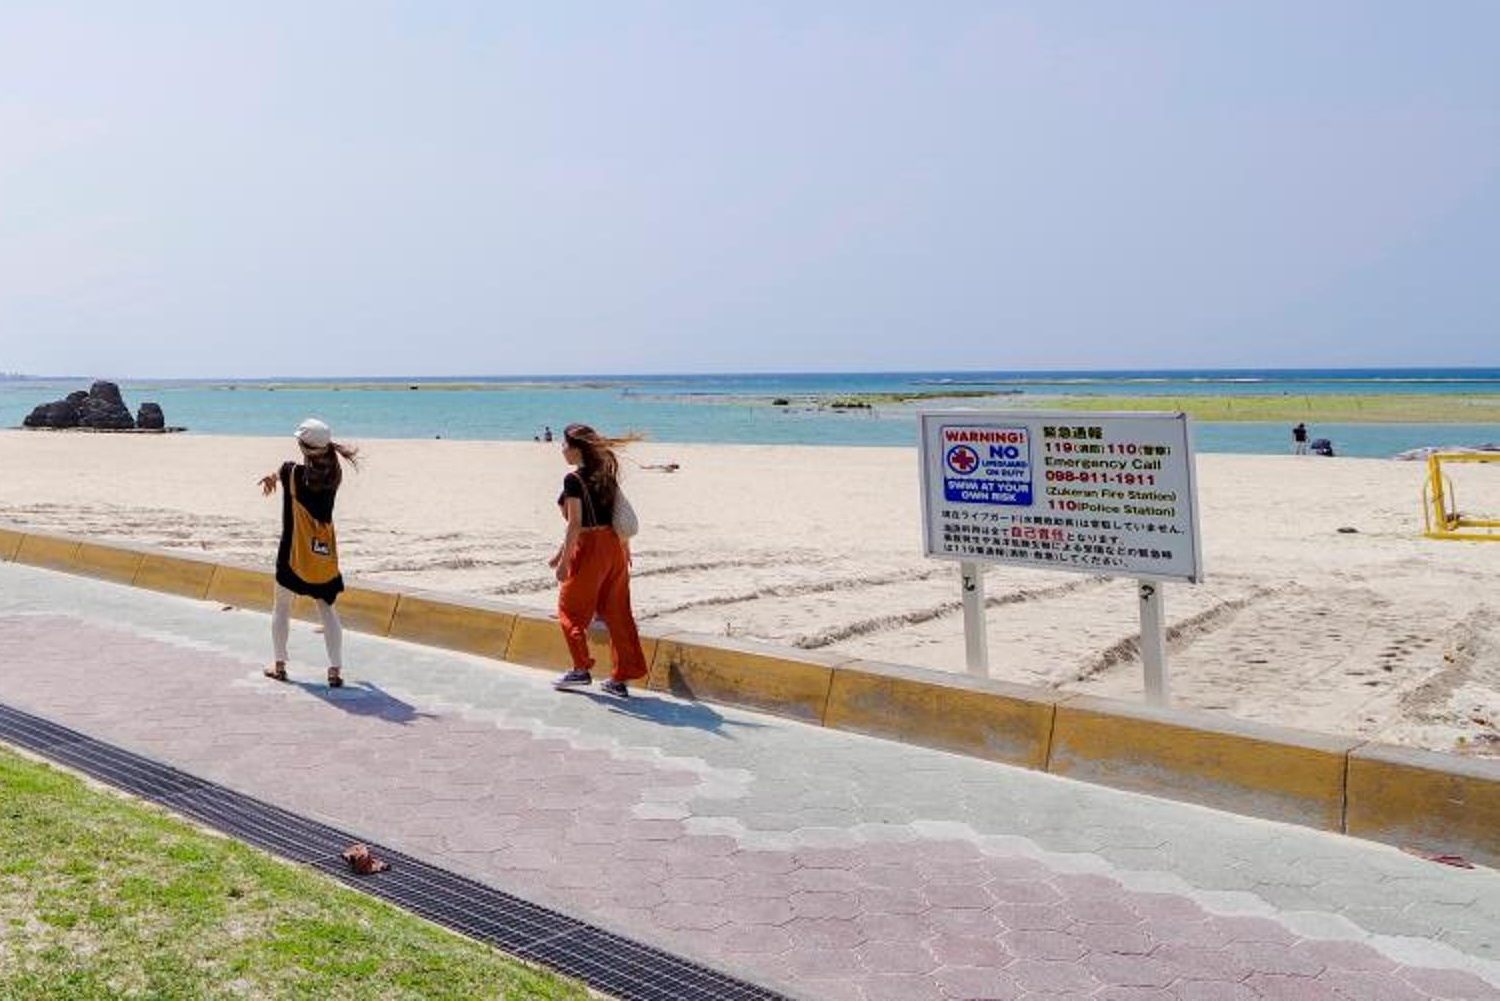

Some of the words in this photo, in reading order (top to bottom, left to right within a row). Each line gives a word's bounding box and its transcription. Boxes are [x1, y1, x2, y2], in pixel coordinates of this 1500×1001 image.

[945, 430, 1024, 443] WARNING!
[989, 445, 1019, 459] NO
[1044, 456, 1127, 470] Emergency
[1132, 458, 1162, 470] Call
[947, 480, 979, 490] SWIM
[981, 482, 995, 491] AT
[997, 483, 1029, 493] YOUR
[961, 491, 989, 500] OWN
[991, 492, 1017, 502] RISK
[1101, 489, 1125, 499] Fire
[1124, 504, 1176, 517] Station)
